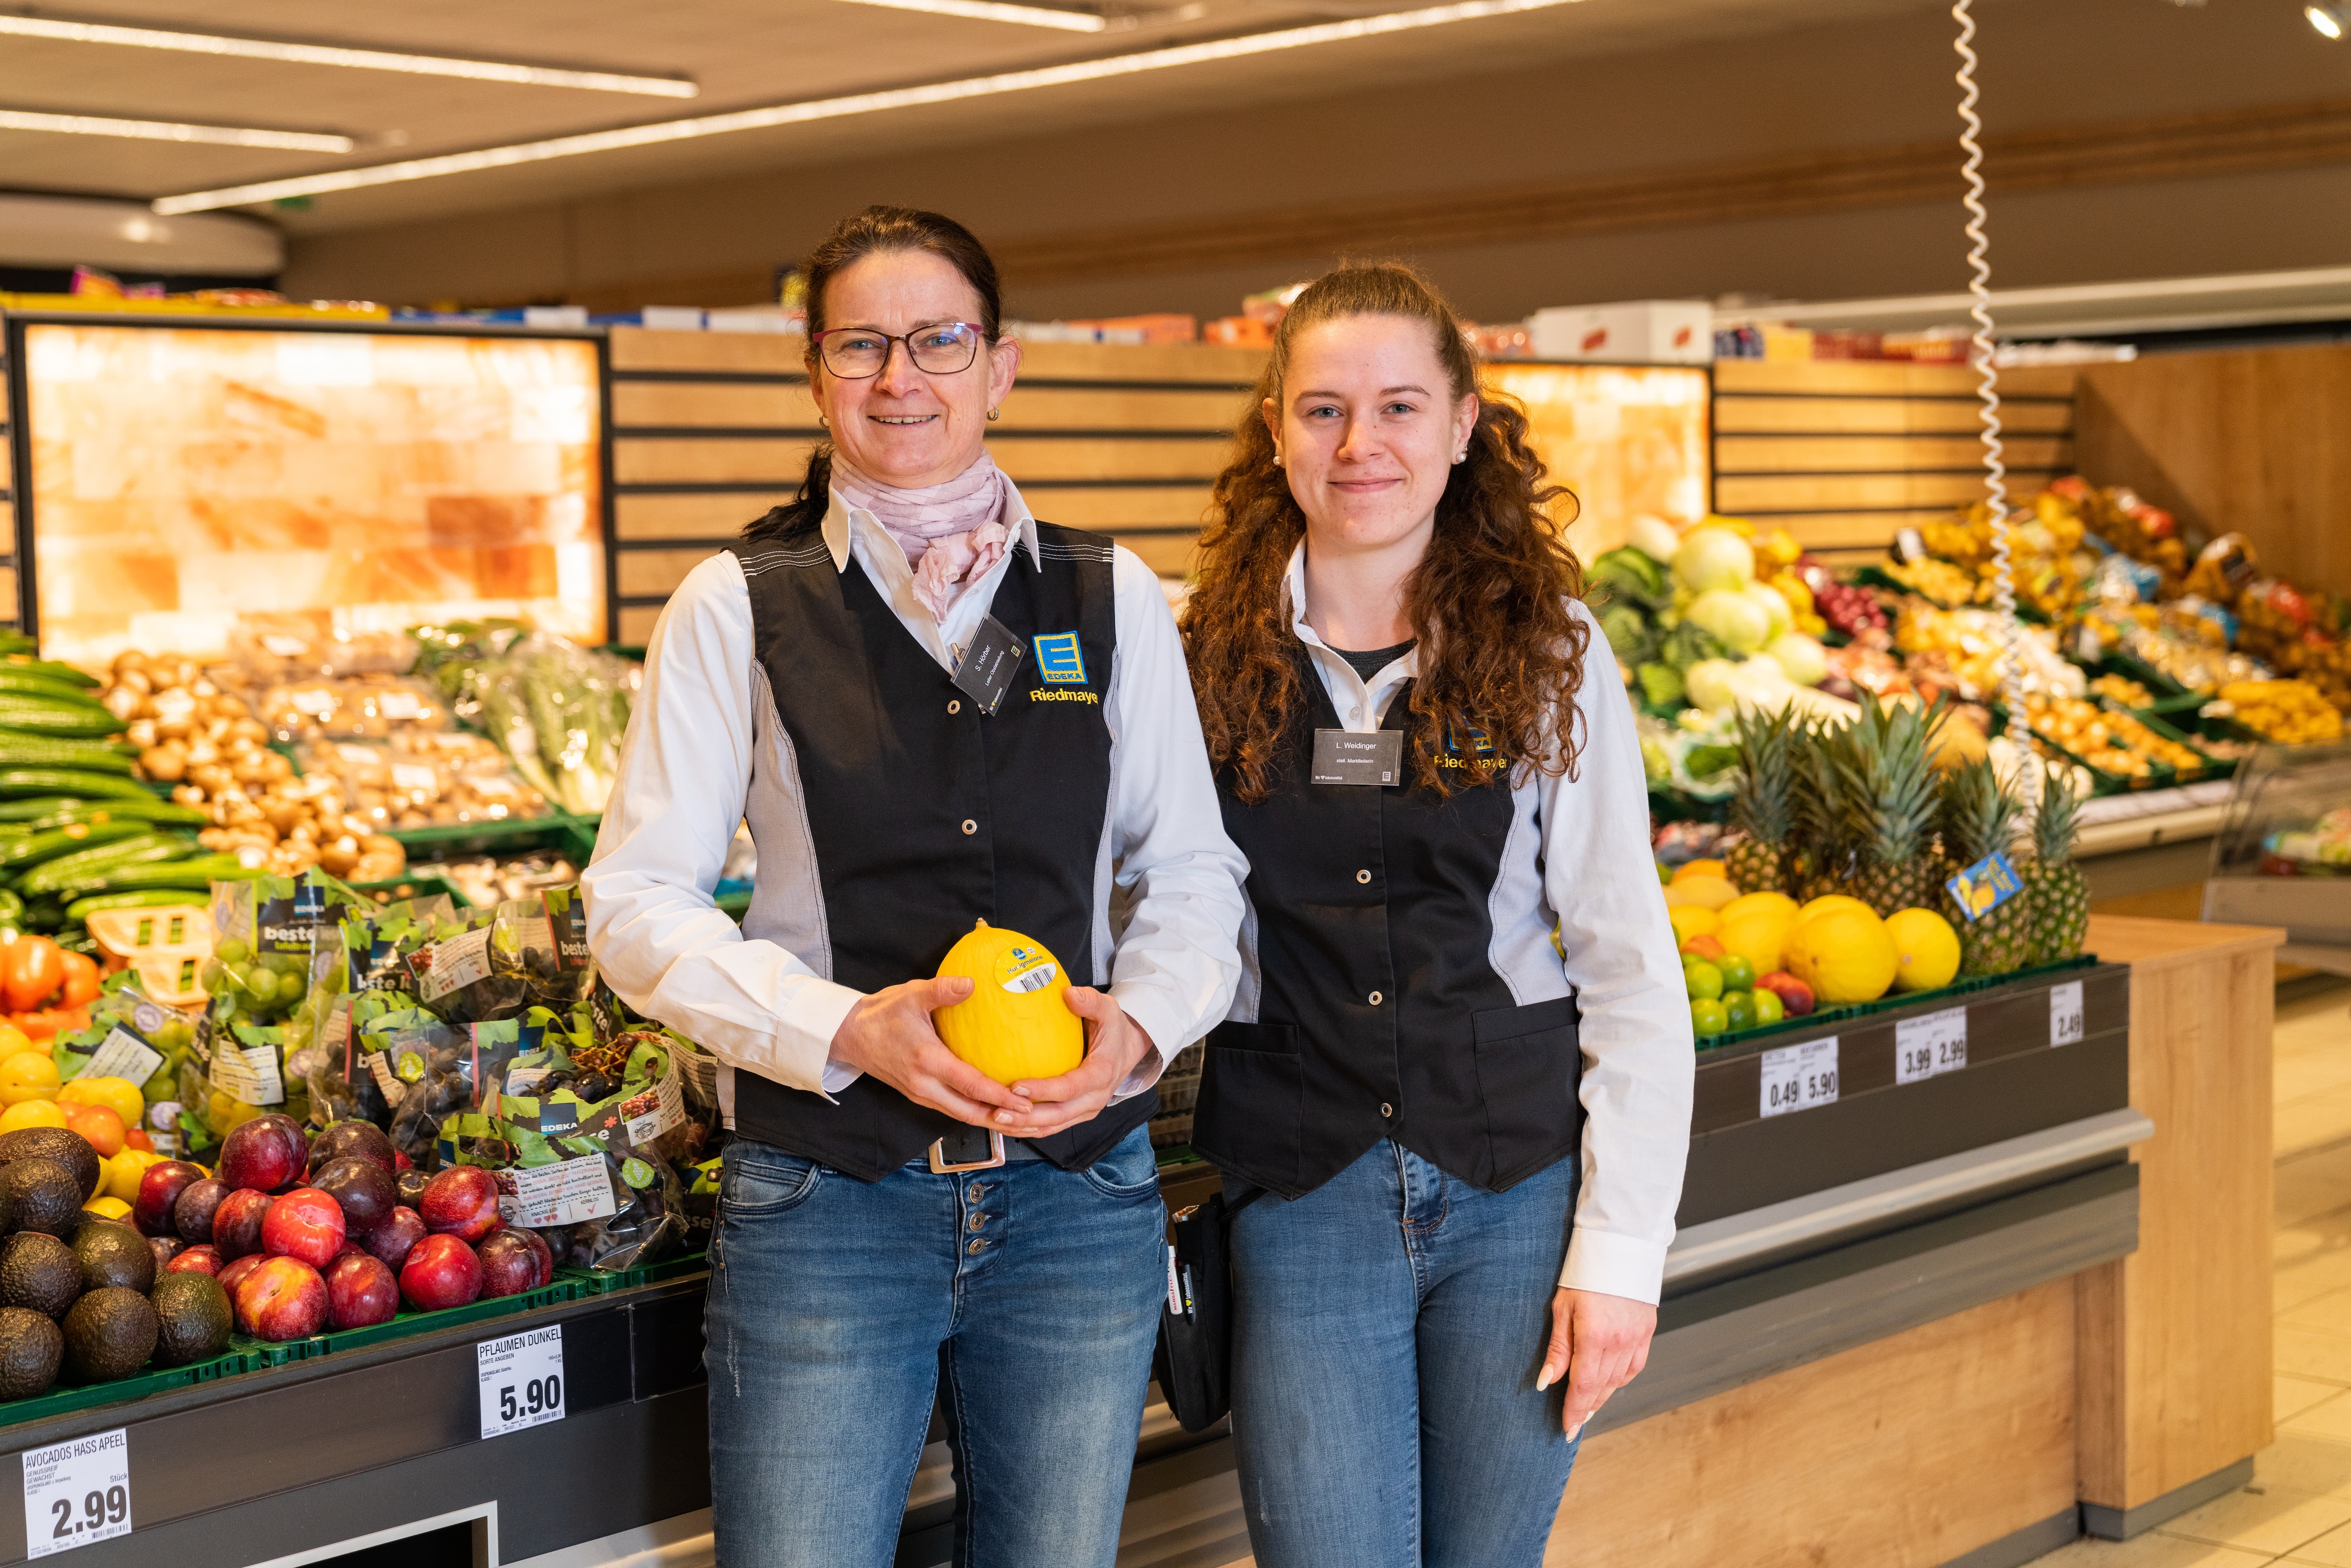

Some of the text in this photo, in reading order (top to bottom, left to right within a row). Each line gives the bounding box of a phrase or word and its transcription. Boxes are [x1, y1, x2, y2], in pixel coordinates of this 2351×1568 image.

[978, 645, 991, 665] Hörber
[990, 650, 1005, 675] Obstabteilung
[1771, 1080, 1797, 1106] 0.49
[1809, 1072, 1835, 1098] 5.90
[541, 1122, 577, 1132] EDEKA
[625, 1173, 652, 1186] DER SAISON
[581, 1197, 600, 1205] KERNLOS
[1182, 1272, 1191, 1299] Lebensmittel.
[480, 1328, 561, 1358] PFLAUMEN DUNKEL
[495, 1353, 514, 1362] ANGEBEN
[501, 1375, 560, 1421] 5.90
[26, 1434, 125, 1469] AVOCADOS HASS APEEL
[26, 1465, 58, 1477] GENUSSREIF
[26, 1473, 55, 1484] GEWACHST
[110, 1473, 128, 1482] Stück
[52, 1485, 126, 1539] 2.99
